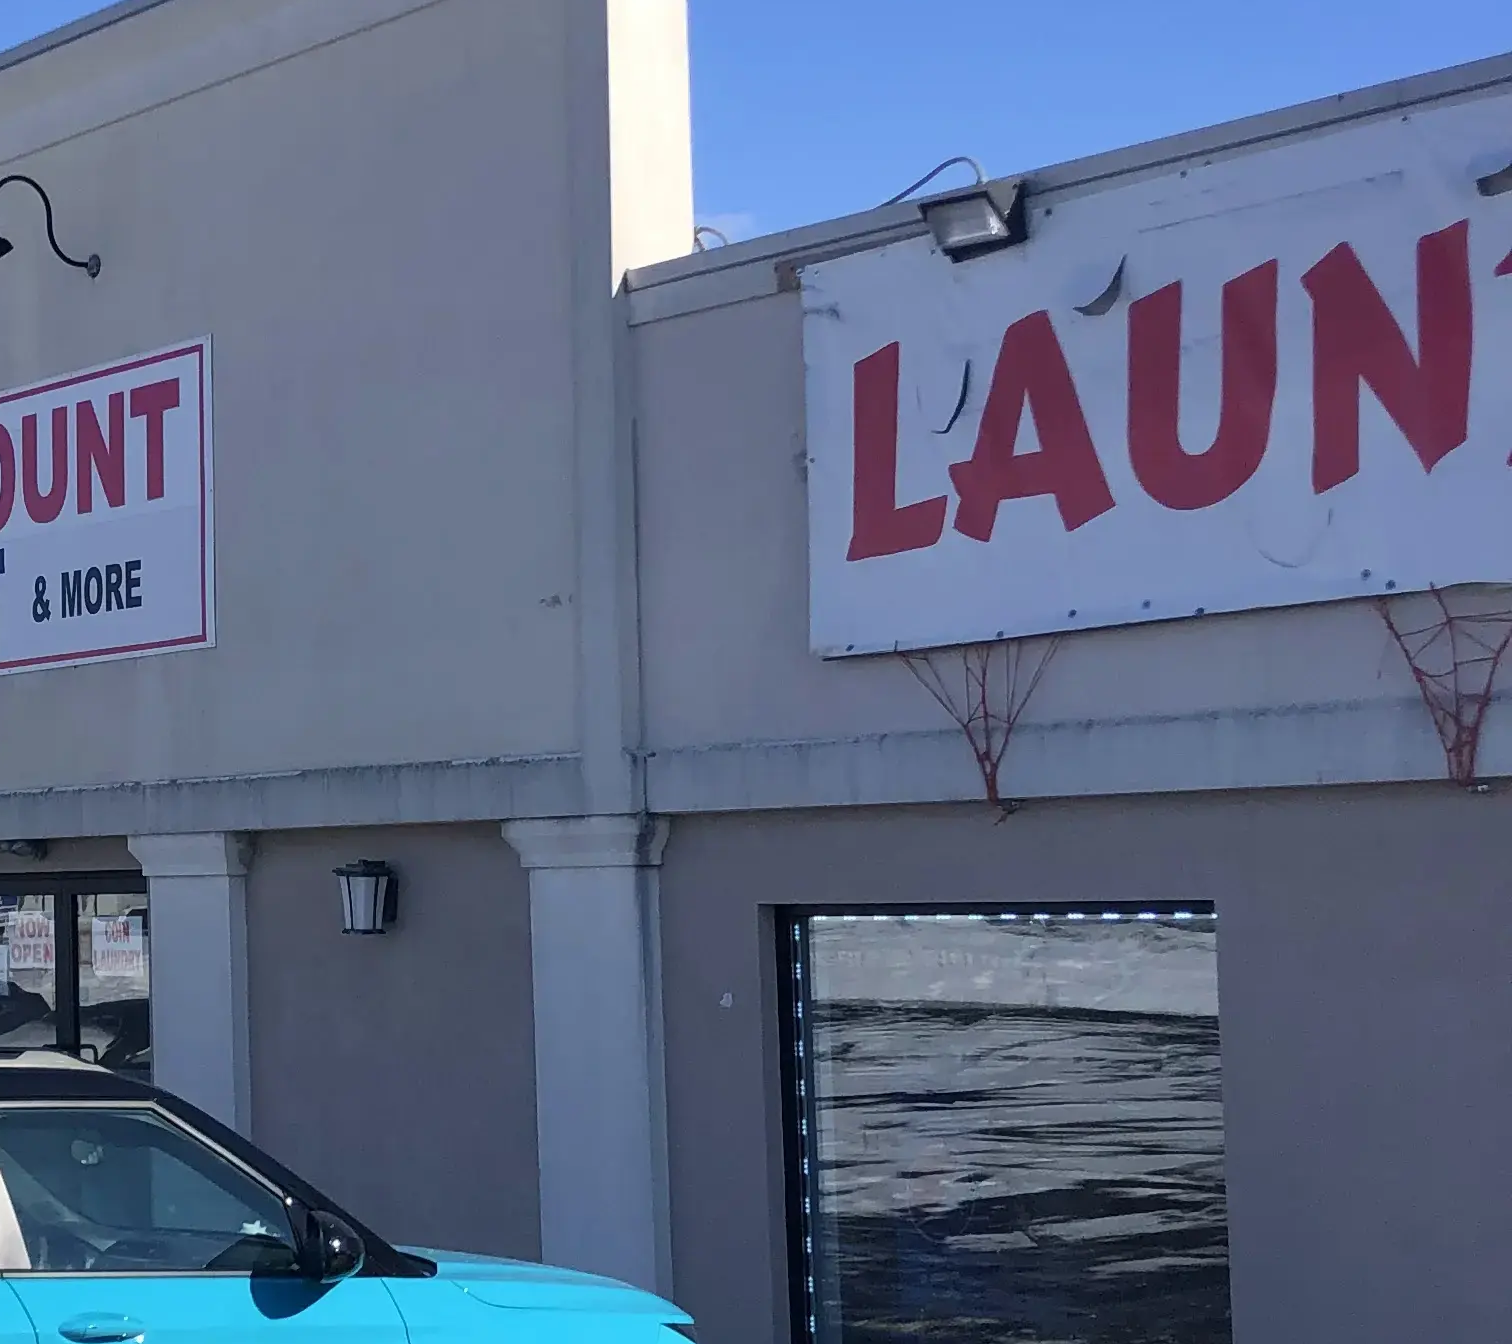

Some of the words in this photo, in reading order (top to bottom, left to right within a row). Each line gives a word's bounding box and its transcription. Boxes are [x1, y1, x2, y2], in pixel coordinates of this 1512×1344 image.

[846, 218, 1512, 562] LAUN
[32, 575, 52, 623] &
[60, 559, 142, 618] MORE
[14, 918, 50, 938] NOW
[105, 921, 130, 943] COIN
[11, 943, 54, 964] OPEN
[93, 949, 141, 971] LAUNDRY
